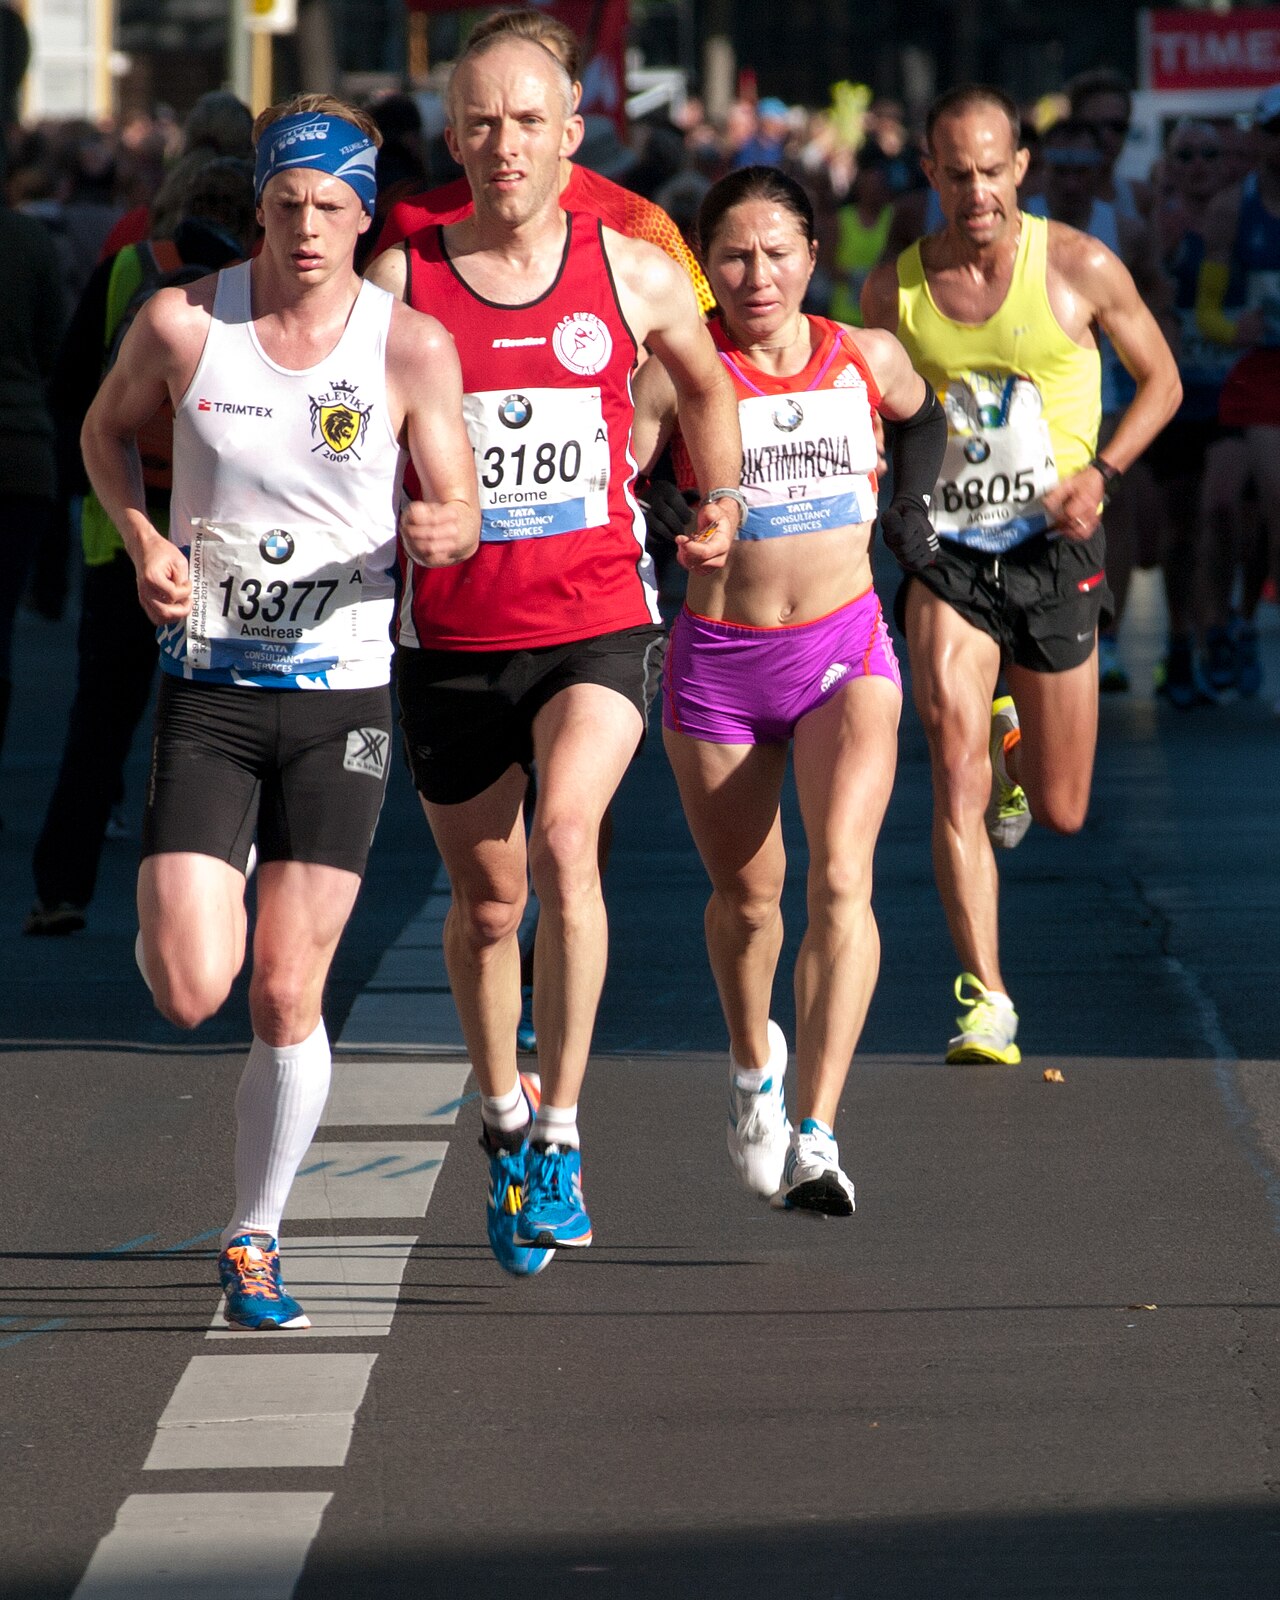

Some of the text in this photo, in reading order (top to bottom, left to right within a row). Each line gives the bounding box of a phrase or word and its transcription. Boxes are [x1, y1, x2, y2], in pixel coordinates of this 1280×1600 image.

[317, 391, 364, 410] SLEVIK
[214, 402, 273, 418] TRIMTEX
[594, 428, 607, 443] A
[322, 449, 350, 463] 2009
[1044, 456, 1055, 469] A
[472, 440, 582, 489] 3180
[787, 485, 808, 499] F7
[942, 468, 1036, 513] 6805
[489, 491, 548, 505] Jerome
[507, 507, 536, 518] TATA
[786, 502, 814, 513] TATA
[490, 515, 554, 529] CONSULTANCY
[770, 509, 832, 526] CONSULTANCY
[503, 526, 544, 538] SERVICES
[782, 520, 823, 534] SERVICES
[193, 532, 203, 618] BERLIN-MARATHON
[349, 569, 363, 584] A
[201, 580, 209, 600] 2012
[219, 575, 340, 623] 13377
[192, 618, 200, 641] BMW
[240, 623, 303, 640] Andreas
[260, 643, 288, 653] TATA
[244, 650, 305, 664] CONSULTANCY
[251, 661, 293, 673] SERVICES
